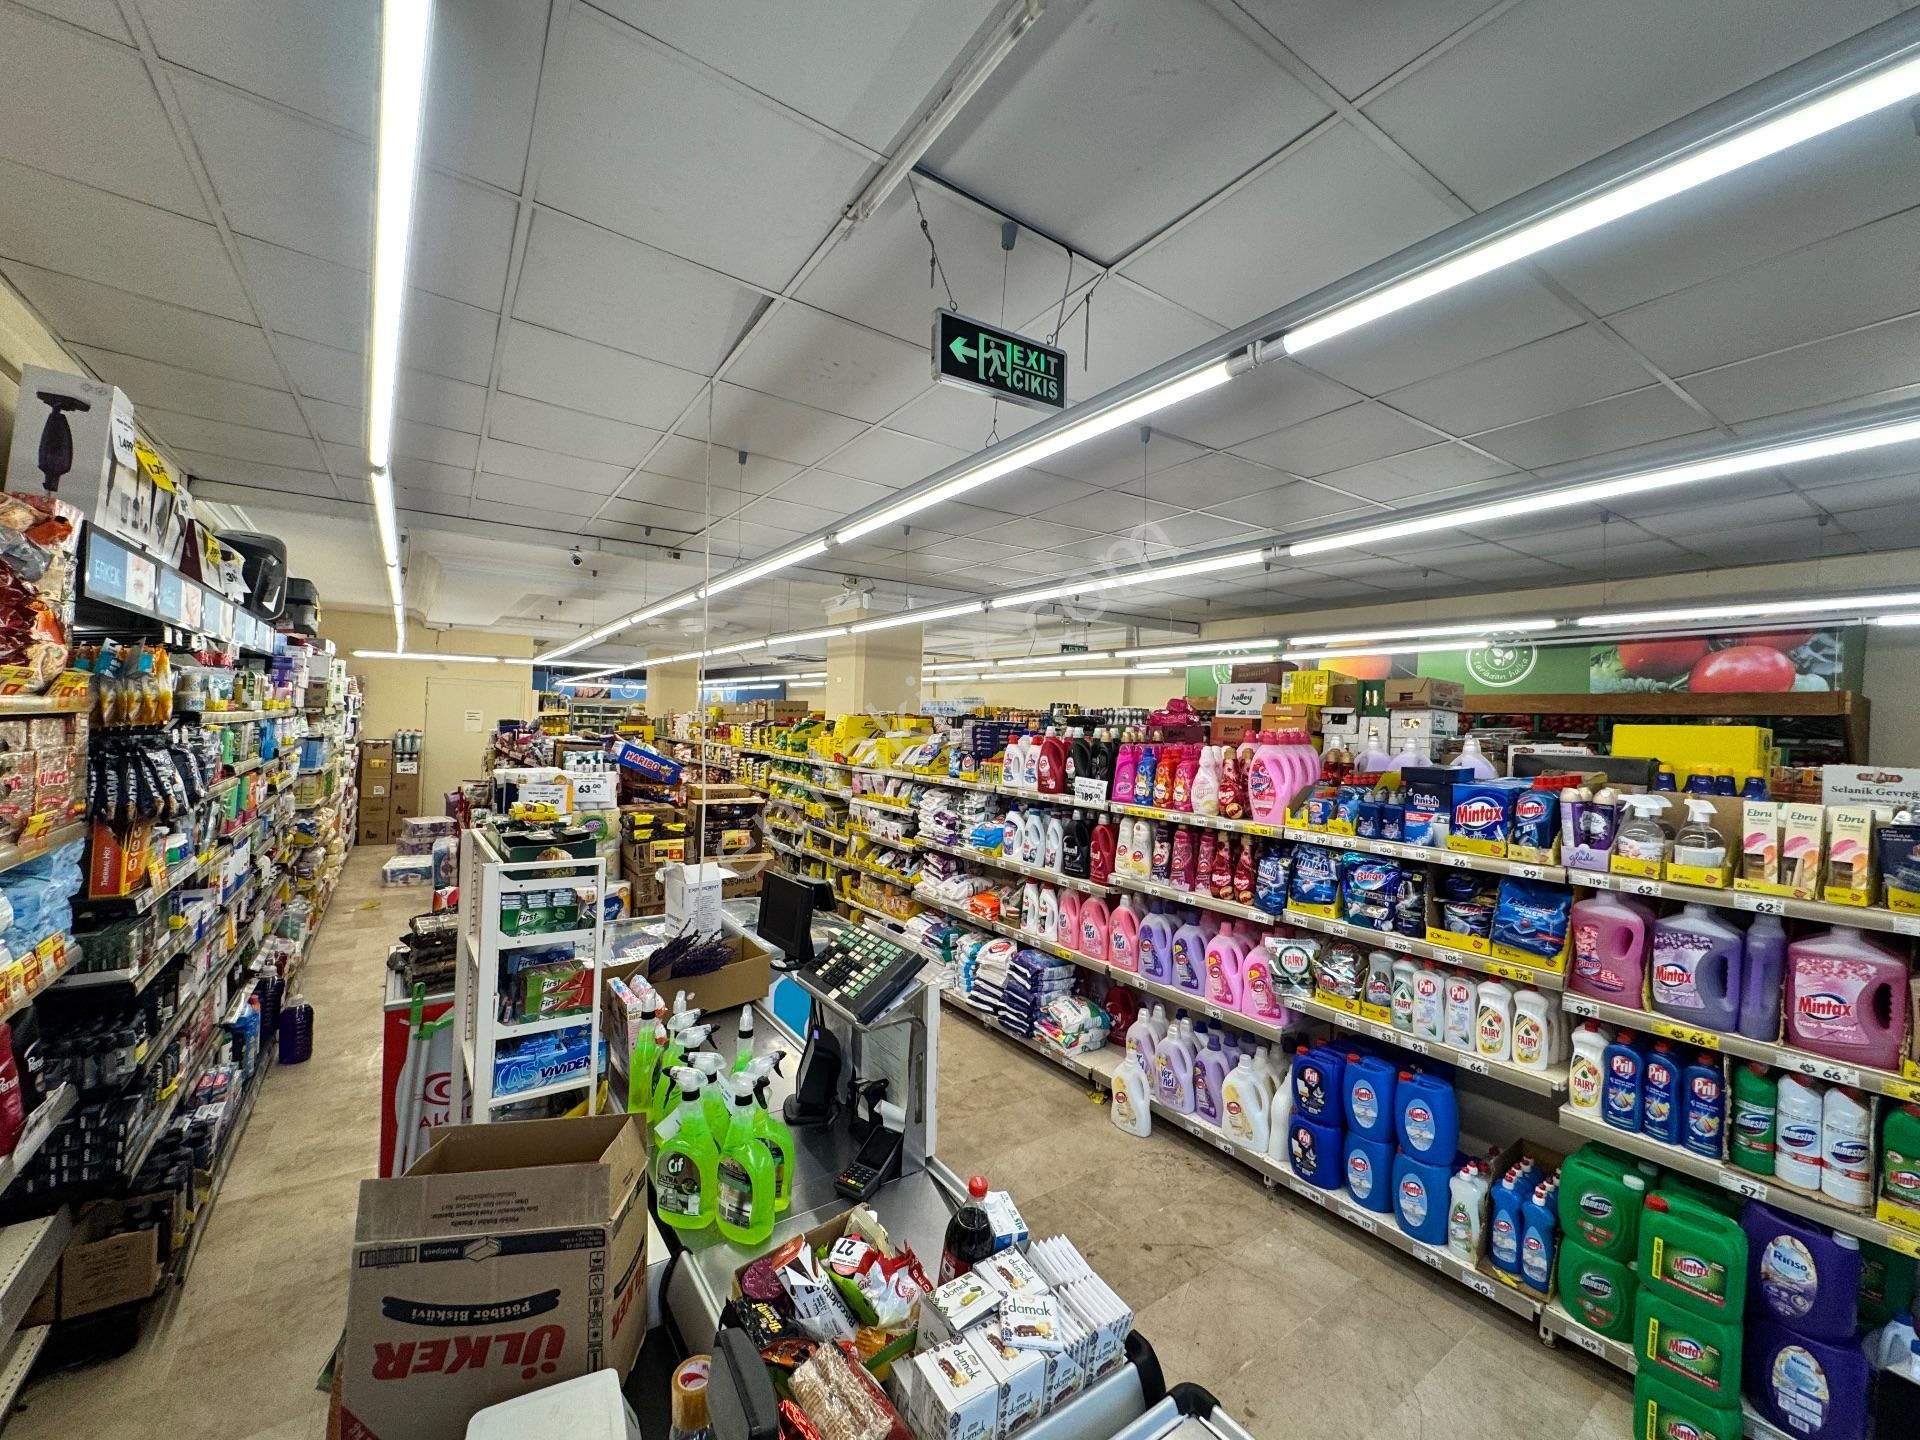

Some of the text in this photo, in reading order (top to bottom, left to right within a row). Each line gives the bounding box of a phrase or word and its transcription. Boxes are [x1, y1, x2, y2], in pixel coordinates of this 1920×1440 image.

[1013, 345, 1059, 376] EXIT
[1012, 371, 1058, 400] ÇIKIŞ
[625, 751, 661, 772] HARIBO
[578, 785, 591, 794] 63
[1831, 785, 1872, 795] Selanik
[1414, 793, 1439, 807] finish
[1456, 805, 1503, 824] Mintax
[1516, 804, 1545, 816] Mintax
[1747, 809, 1772, 818] Ebru
[1790, 812, 1817, 822] Ebru
[1836, 814, 1865, 824] Ebru
[1297, 855, 1328, 872] finish
[1454, 859, 1465, 867] 26
[1569, 853, 1595, 866] glade
[1354, 871, 1386, 882] Bingo
[1523, 870, 1536, 878] 99
[1637, 886, 1653, 894] 62
[1756, 903, 1774, 913] 62
[519, 912, 538, 922] First
[1113, 933, 1123, 942] Ver
[1115, 940, 1125, 950] nel
[1284, 953, 1304, 967] FAIRY
[1516, 972, 1528, 981] 175
[1656, 966, 1691, 984] Mintax
[542, 979, 560, 989] First
[1419, 982, 1435, 993] Pril
[1451, 988, 1467, 1000] Pril
[541, 997, 559, 1008] First
[1394, 999, 1412, 1010] FAIRY
[1800, 997, 1851, 1017] Mintax
[1576, 1006, 1591, 1016] 99
[1382, 1033, 1392, 1041] 53
[1481, 1026, 1500, 1038] FAIRY
[1517, 1035, 1537, 1047] FAIRY
[1690, 1035, 1705, 1045] 66
[1412, 1043, 1423, 1052] 93
[1470, 1063, 1482, 1072] 66
[1613, 1056, 1633, 1072] Pril
[1160, 1066, 1172, 1080] Ver
[1304, 1069, 1318, 1081] Pril
[1648, 1065, 1668, 1082] Pril
[1822, 1069, 1841, 1081] 66
[1162, 1078, 1175, 1088] nel
[1574, 1078, 1596, 1091] FAIRY
[1695, 1079, 1716, 1096] Pril
[1354, 1089, 1374, 1100] Mintax
[1408, 1109, 1430, 1120] Mintax
[668, 1158, 684, 1173] Cif
[1351, 1158, 1369, 1171] Mintax
[1402, 1182, 1424, 1196] Mintax
[1740, 1184, 1757, 1195] 57
[1581, 1197, 1613, 1214] Domestos
[836, 1239, 854, 1254] 27
[1425, 1255, 1437, 1267] 38
[1673, 1257, 1710, 1277] Mintax
[1773, 1249, 1808, 1272] Rinso
[1008, 1258, 1034, 1284] damak
[943, 1281, 972, 1298] damak
[1474, 1282, 1489, 1295] 40
[1580, 1277, 1612, 1294] Domestos
[821, 1283, 857, 1328] Biscolata
[1008, 1297, 1052, 1316] damak
[411, 1306, 470, 1322] Bisküvi
[755, 1302, 783, 1334] Browni
[1095, 1339, 1118, 1362] damak
[1580, 1338, 1597, 1350] 169
[1668, 1339, 1705, 1360] Mintax
[372, 1325, 566, 1381] ÜLKER
[953, 1349, 981, 1380] damak
[1053, 1366, 1077, 1391] damak
[1007, 1391, 1034, 1416] damak
